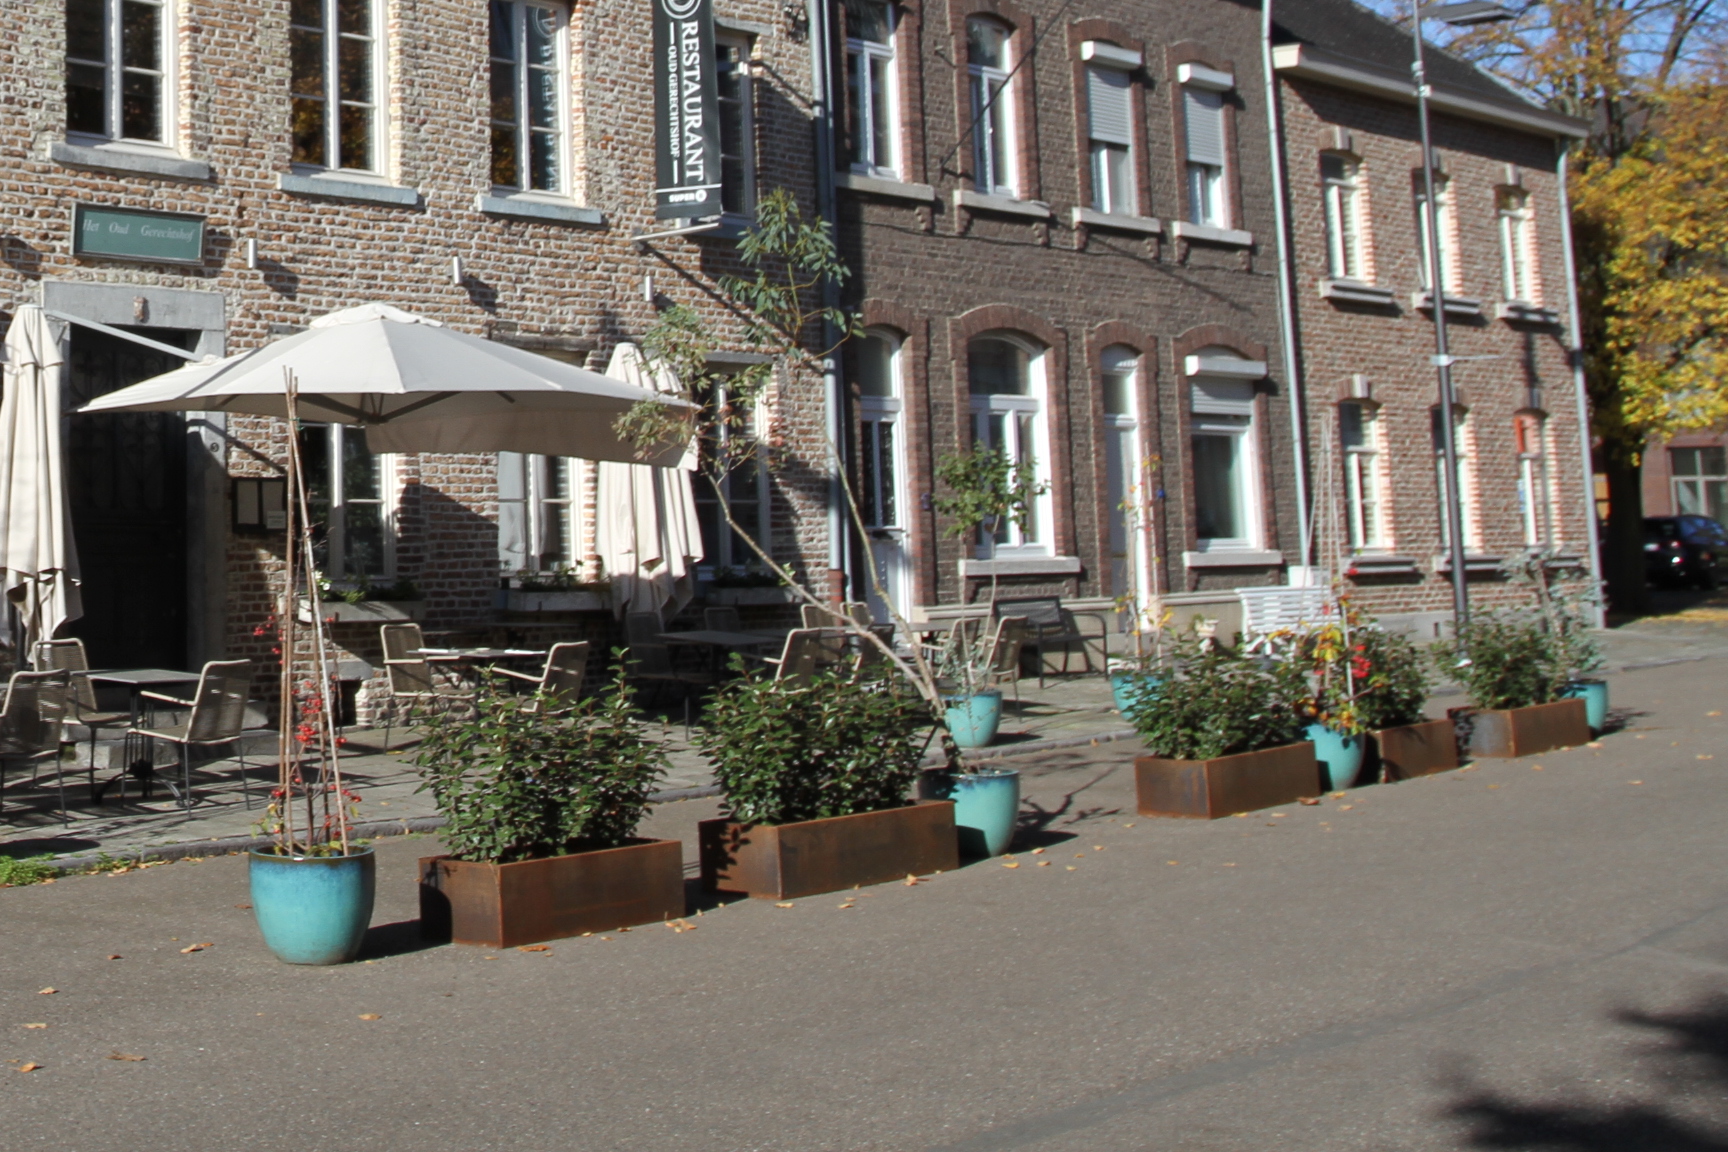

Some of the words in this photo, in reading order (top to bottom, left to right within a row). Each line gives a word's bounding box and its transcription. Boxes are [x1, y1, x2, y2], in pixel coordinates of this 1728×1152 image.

[668, 45, 678, 73] OUD
[668, 73, 680, 158] GERECHTSHOF
[681, 19, 704, 182] RESTAURANT
[82, 219, 100, 233] Het
[109, 221, 130, 235] Oud
[140, 224, 194, 243] Gerechtshof
